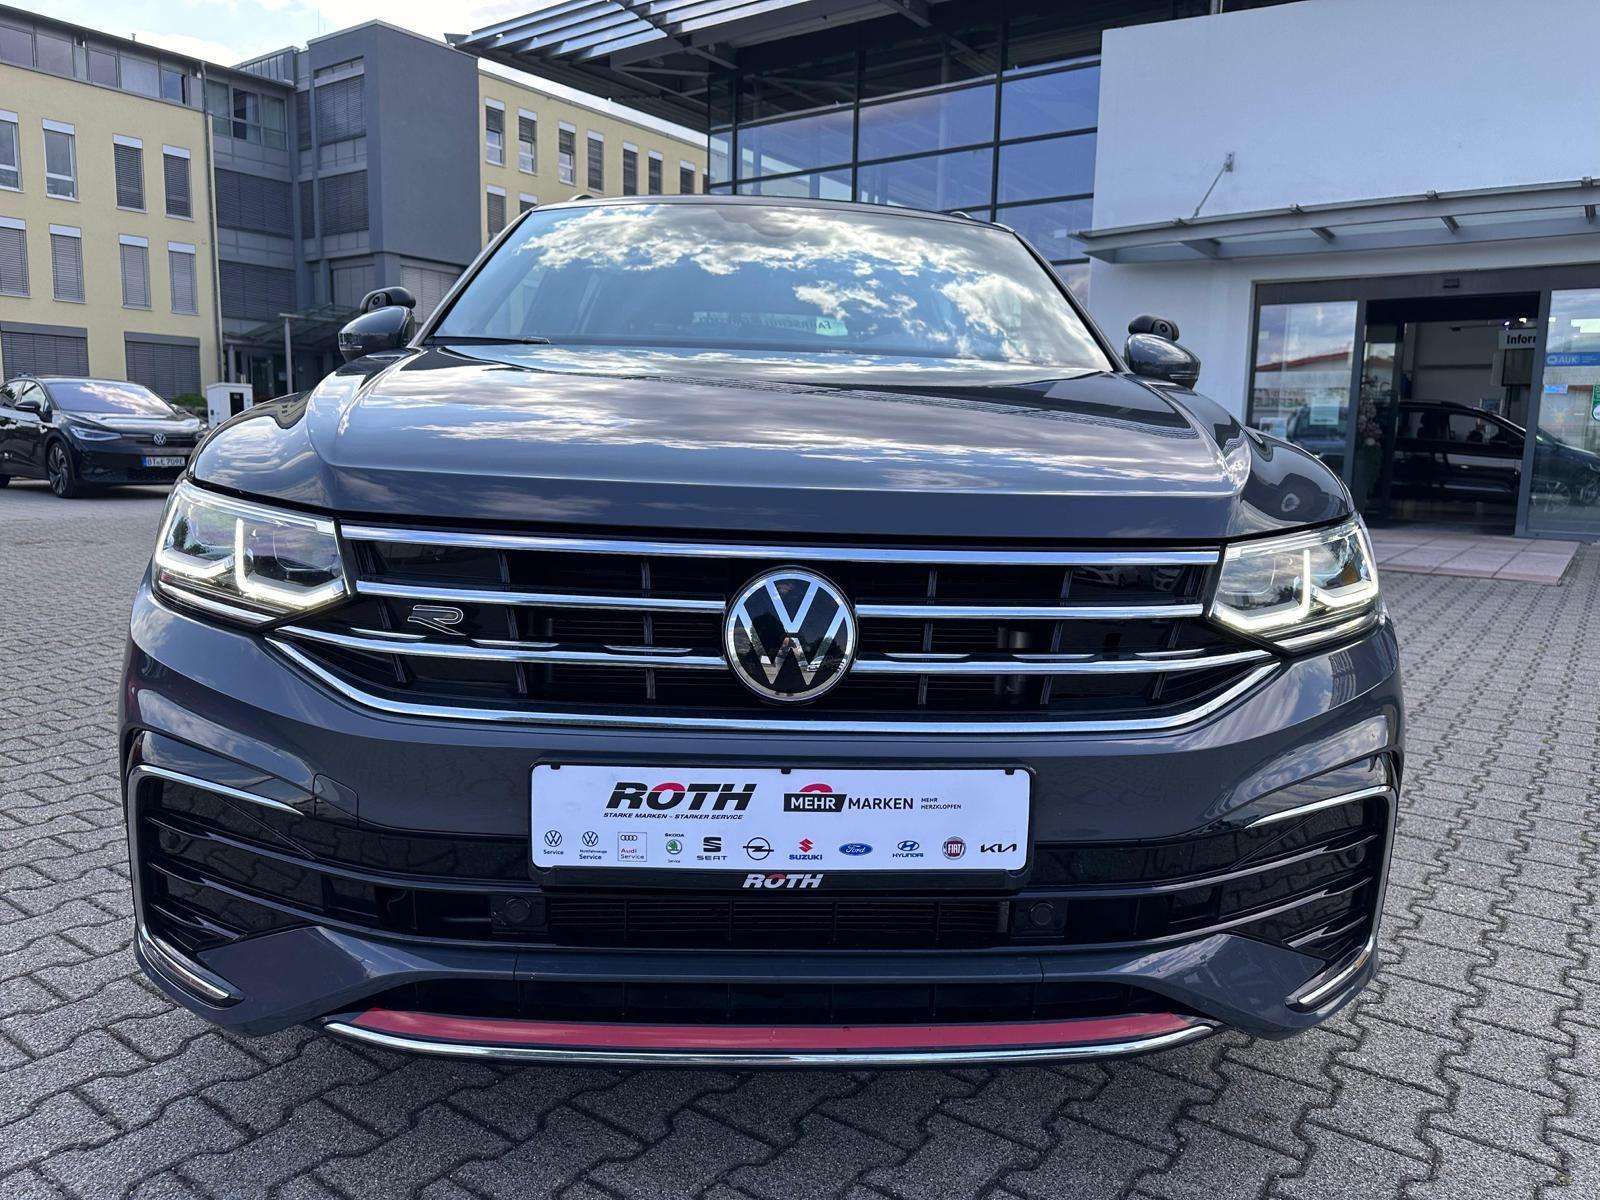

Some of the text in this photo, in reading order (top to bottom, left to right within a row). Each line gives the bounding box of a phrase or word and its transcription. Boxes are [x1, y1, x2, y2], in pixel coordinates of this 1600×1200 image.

[407, 604, 465, 635] R
[727, 570, 855, 701] VW
[606, 781, 757, 811] ROTH
[790, 796, 914, 810] MEHR MARKEN
[845, 843, 866, 854] Ford
[946, 844, 963, 854] FIAT
[980, 843, 1018, 853] KIA
[742, 872, 824, 889] ROTH
